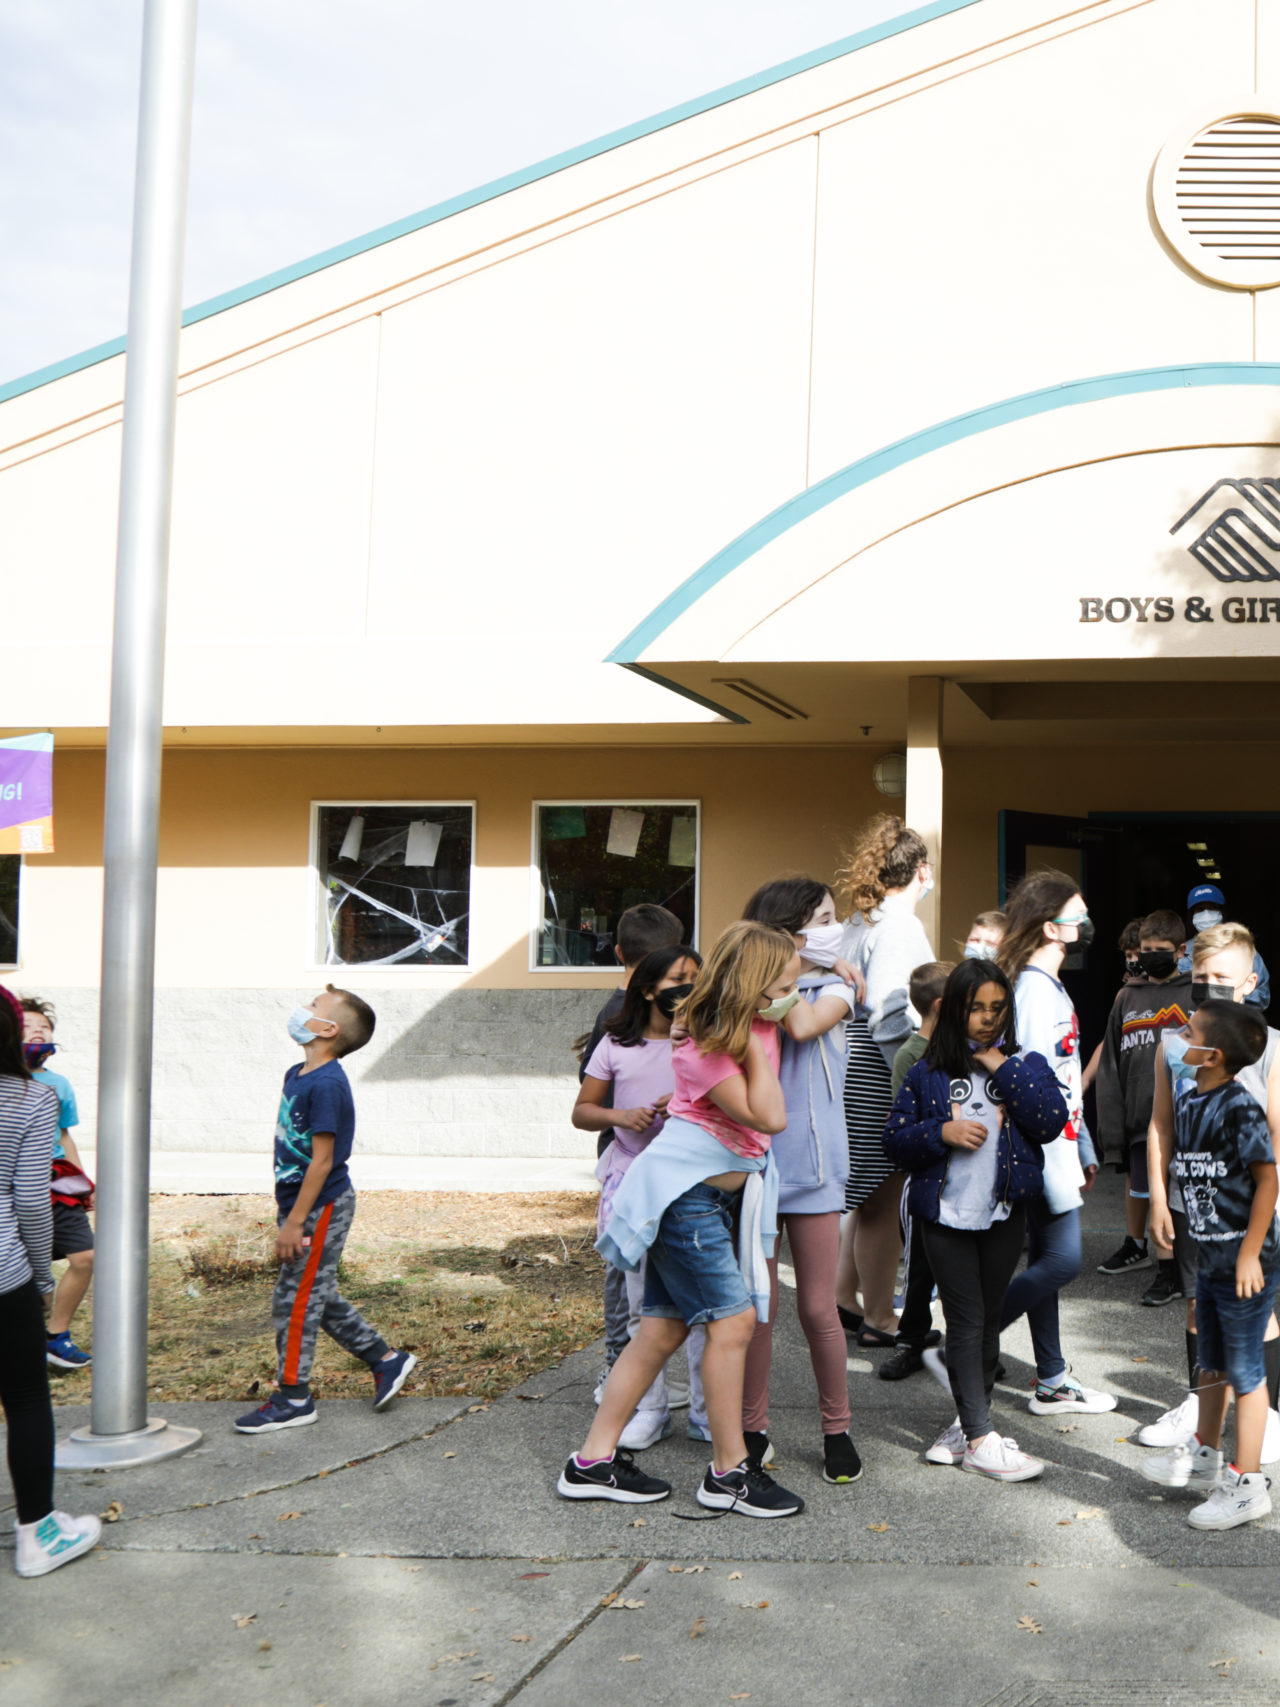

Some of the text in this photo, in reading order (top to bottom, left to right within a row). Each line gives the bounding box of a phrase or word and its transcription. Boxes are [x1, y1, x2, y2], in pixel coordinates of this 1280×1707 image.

[1079, 596, 1174, 623] BOYS
[1184, 596, 1214, 623] &
[1190, 1161, 1227, 1178] COWS
